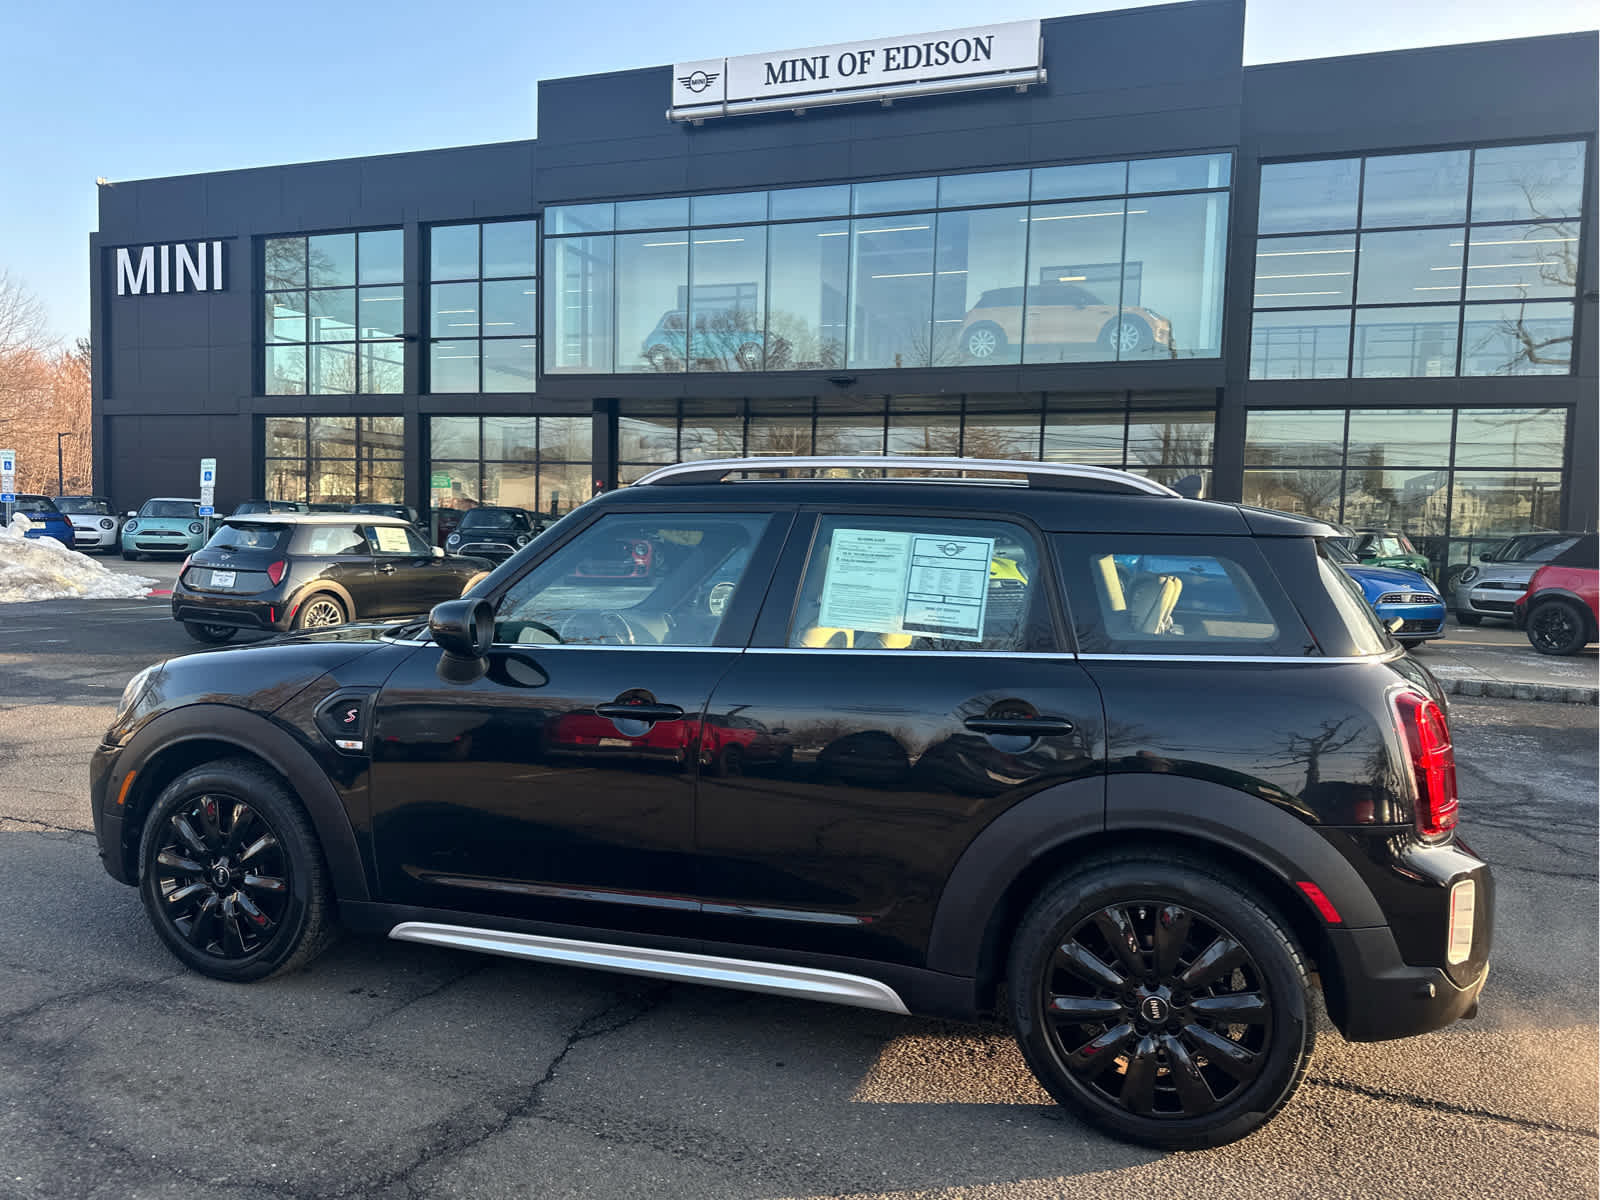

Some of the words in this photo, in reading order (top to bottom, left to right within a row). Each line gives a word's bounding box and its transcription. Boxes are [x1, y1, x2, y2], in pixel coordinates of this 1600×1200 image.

[764, 55, 830, 86] MINI
[837, 50, 875, 77] OF
[882, 35, 994, 70] EDISON
[691, 78, 706, 86] MINI
[116, 241, 222, 296] MINI
[343, 709, 358, 723] S
[1150, 1000, 1161, 1019] MINI
